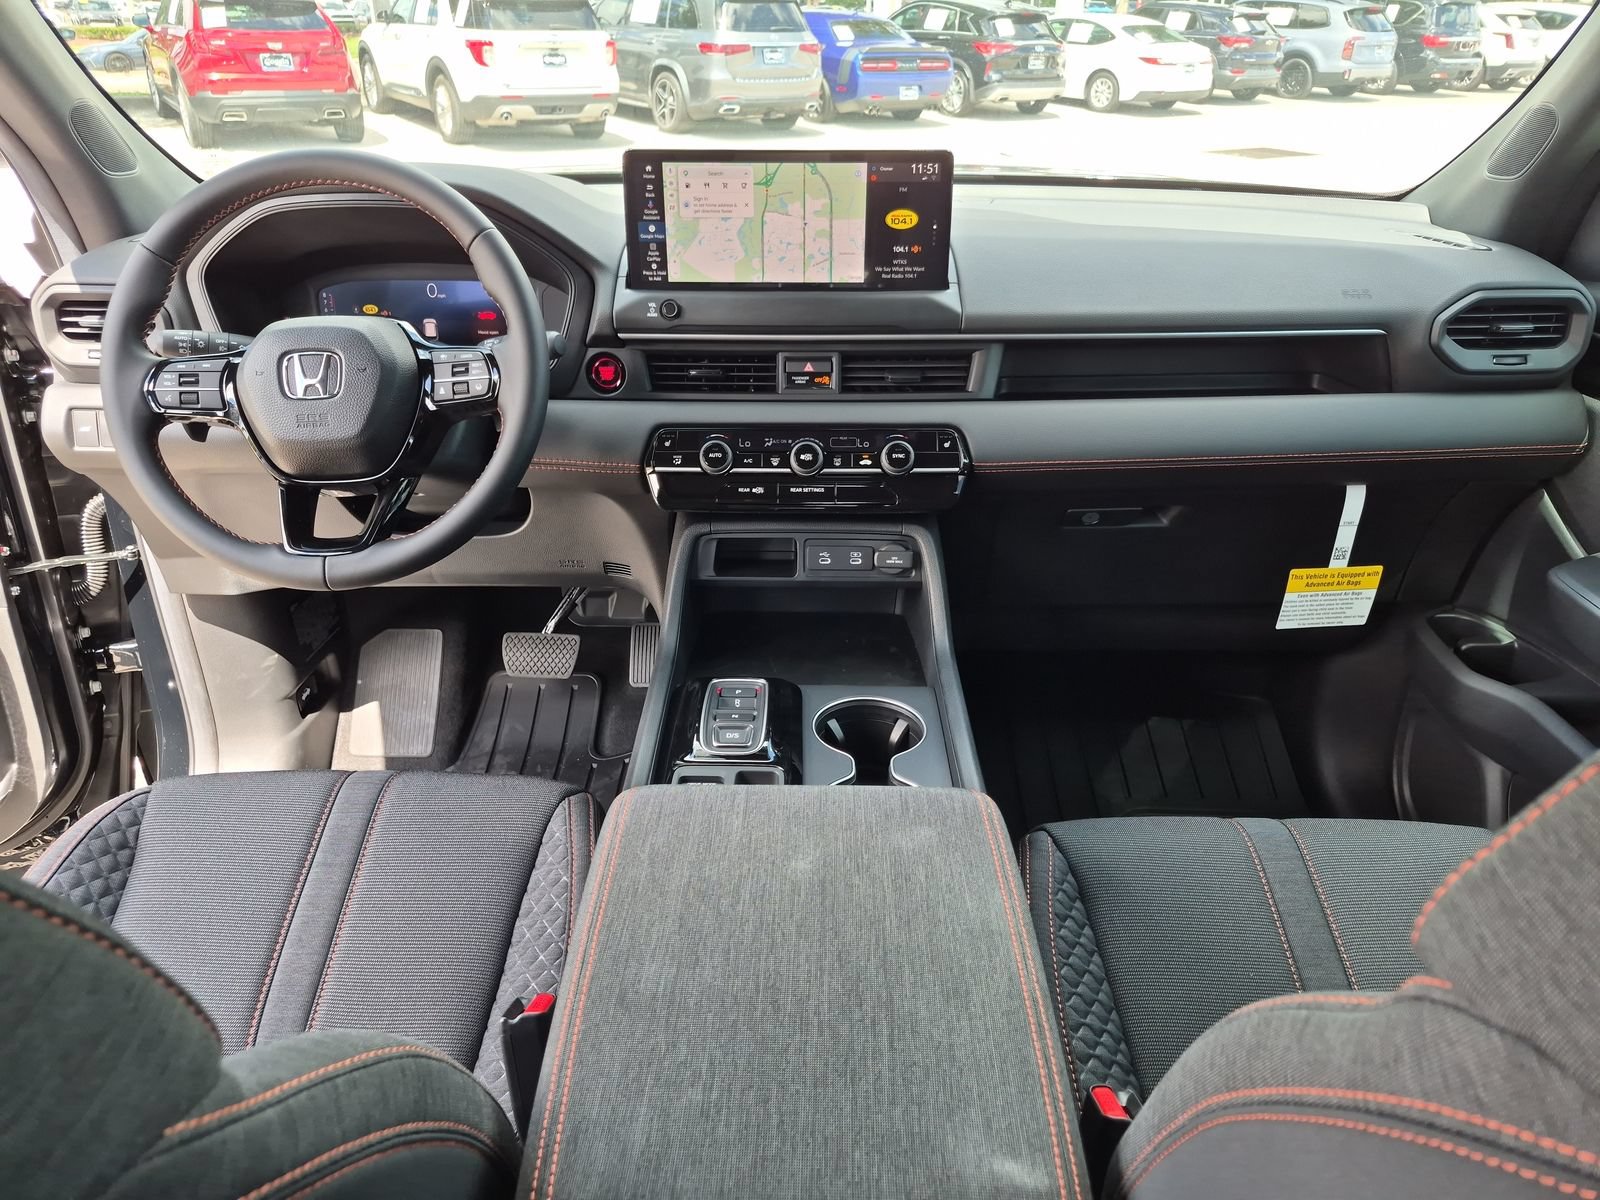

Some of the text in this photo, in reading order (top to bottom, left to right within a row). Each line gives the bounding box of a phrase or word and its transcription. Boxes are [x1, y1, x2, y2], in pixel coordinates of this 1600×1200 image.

[911, 163, 939, 174] 11:51
[890, 217, 913, 225] 104.1
[893, 245, 908, 253] 104.1
[427, 283, 438, 298] 0
[1305, 572, 1329, 580] Vehicle
[1337, 571, 1365, 579] Equipped
[1346, 579, 1361, 587] Bags
